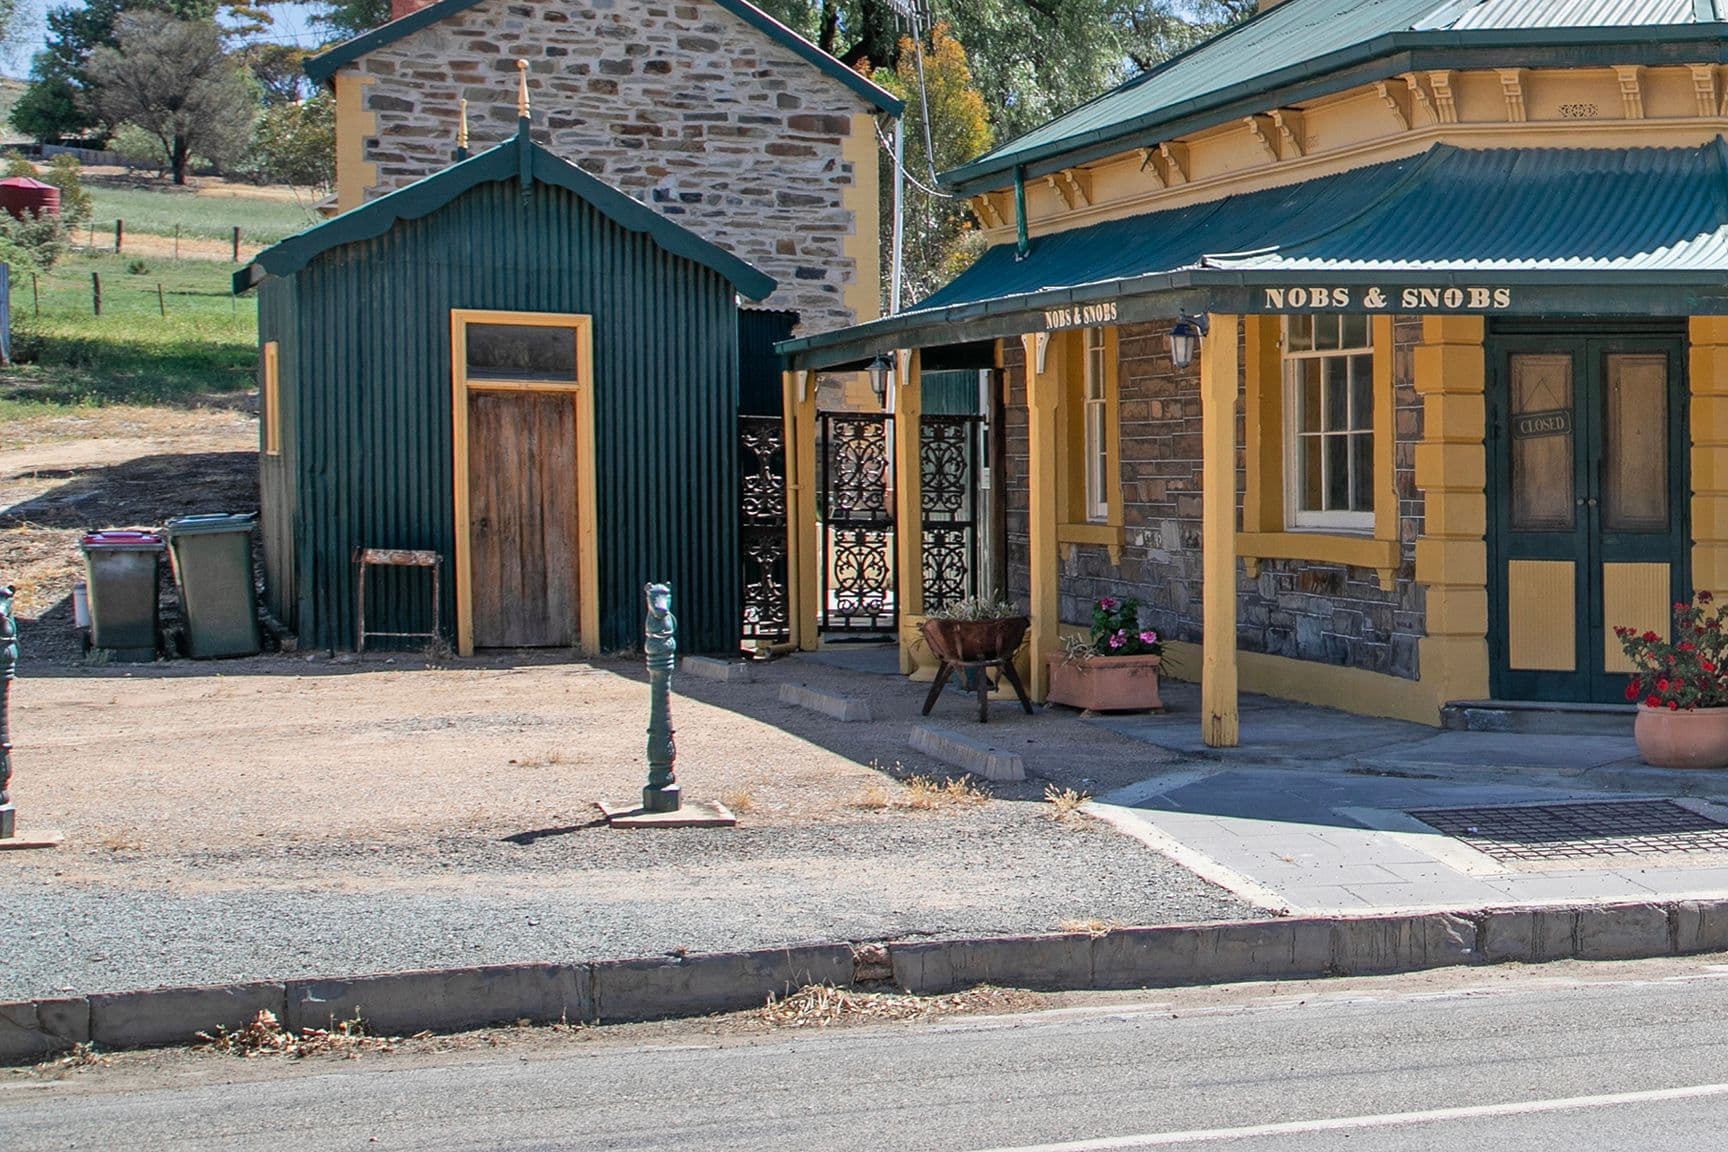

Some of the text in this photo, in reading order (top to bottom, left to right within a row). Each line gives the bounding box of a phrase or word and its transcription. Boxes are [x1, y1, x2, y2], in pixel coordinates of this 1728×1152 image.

[1264, 286, 1511, 309] NOBS & SNOBS
[1044, 302, 1117, 330] NOBS & SNOBS
[1520, 416, 1565, 434] CLOSED
